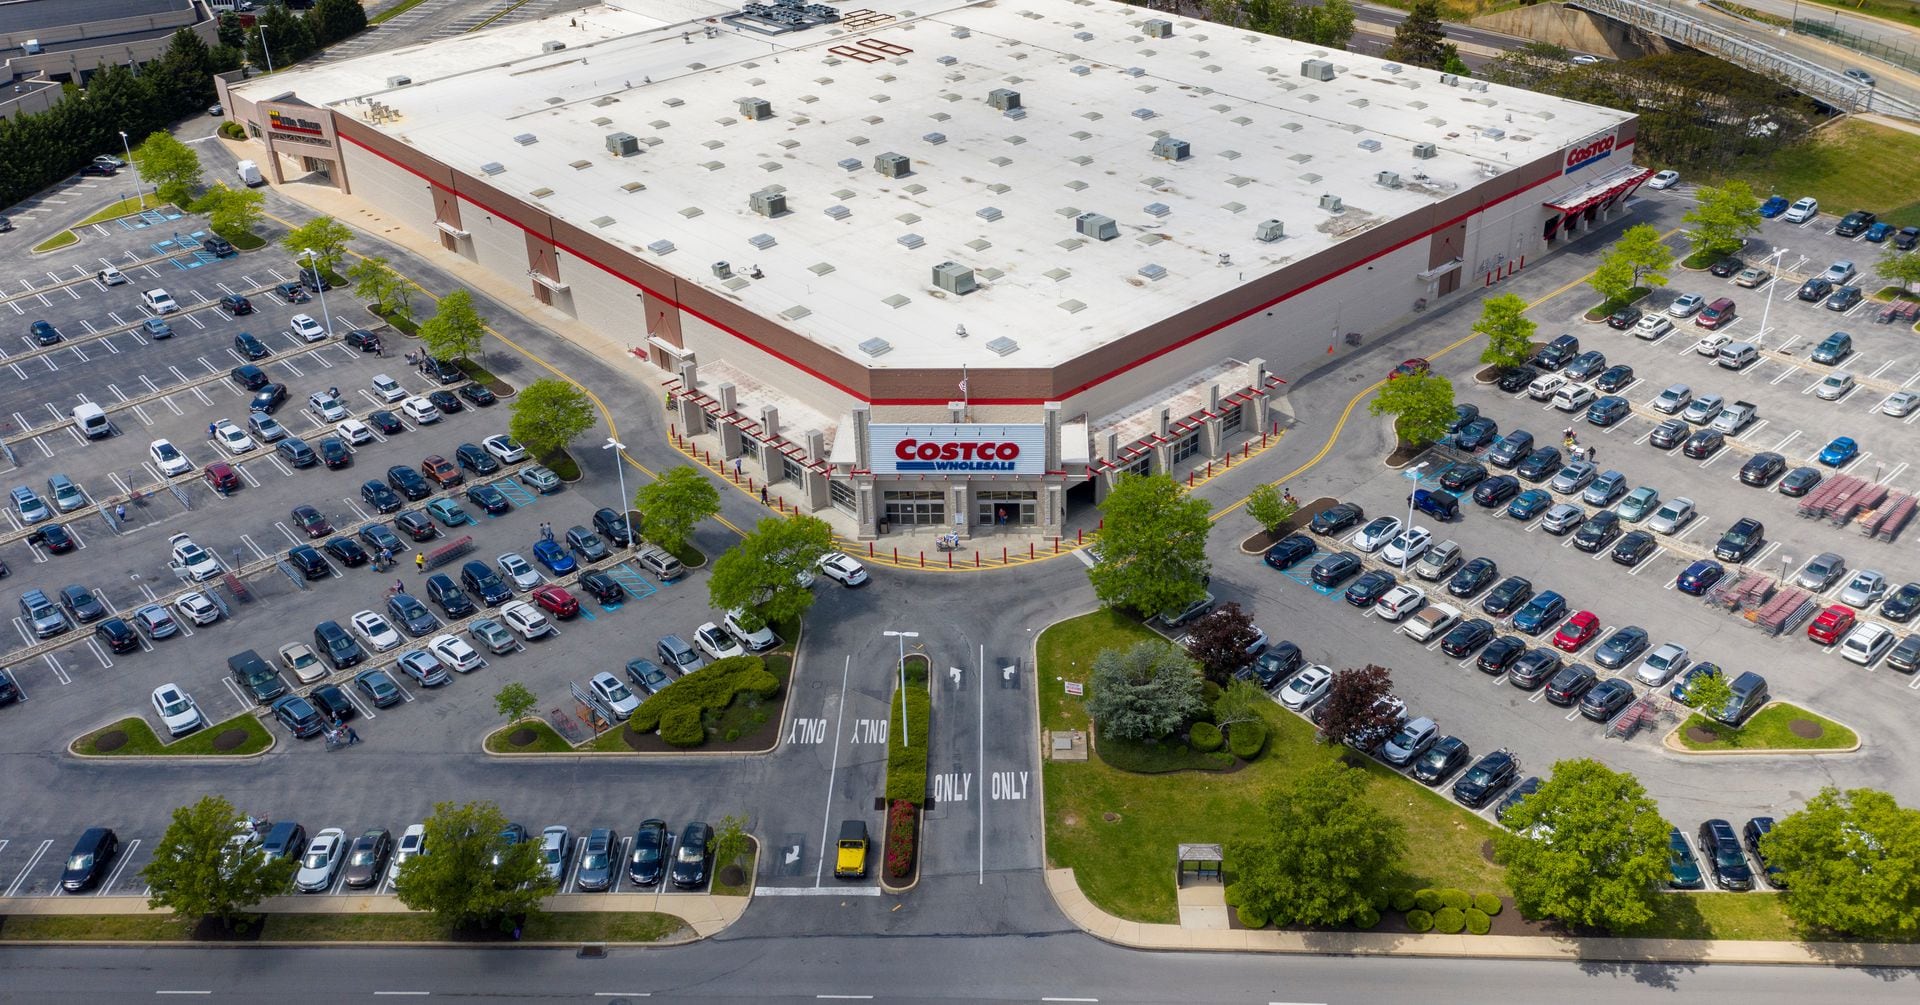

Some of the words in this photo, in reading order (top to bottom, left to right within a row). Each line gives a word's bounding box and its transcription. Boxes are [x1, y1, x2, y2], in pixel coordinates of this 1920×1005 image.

[1567, 135, 1615, 166] COSTCO
[895, 438, 1020, 461] COSTCO
[935, 461, 1016, 471] WHOLESALE
[787, 718, 827, 744] ONLY
[850, 719, 888, 744] ONLY
[934, 773, 972, 802] ONLY
[992, 771, 1028, 800] ONLY
